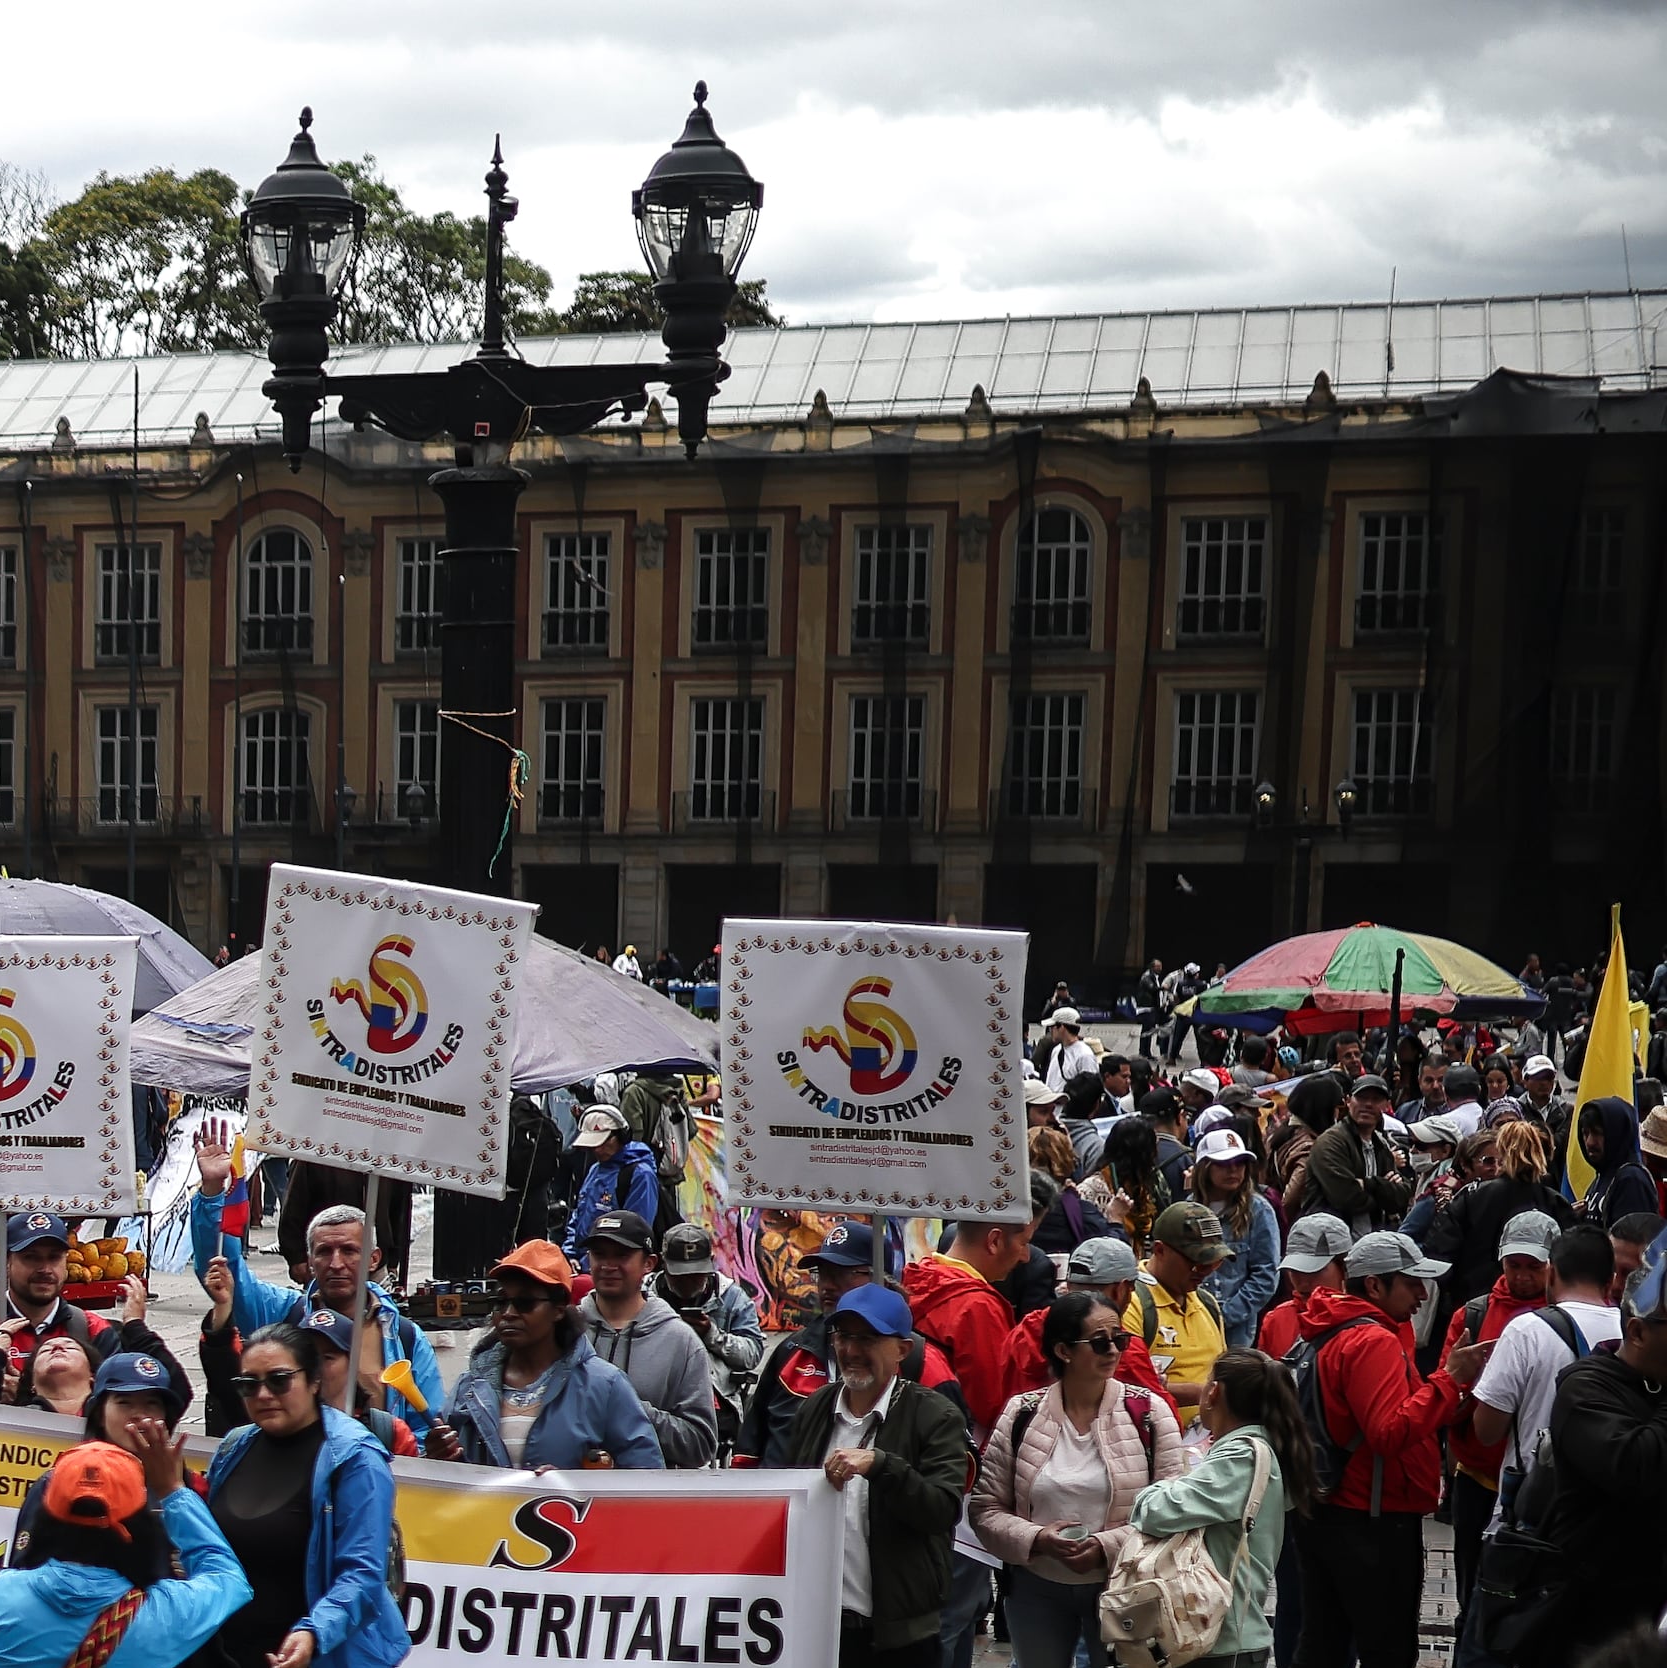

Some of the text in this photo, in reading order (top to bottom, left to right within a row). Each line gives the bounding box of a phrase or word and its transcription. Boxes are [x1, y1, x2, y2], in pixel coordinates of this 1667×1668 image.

[306, 998, 464, 1085] SINTRADISTRITALES
[292, 1072, 336, 1091] SINDICATO
[337, 1081, 348, 1094] DE
[349, 1083, 396, 1104] EMPLEADOS
[405, 1093, 466, 1117] TRABAJADORES
[777, 1050, 962, 1124] SINTRADISTRITALES
[322, 1108, 423, 1134] sintradistritalesjd@gmail.com
[769, 1125, 820, 1138] SINDICATO
[822, 1127, 835, 1140] DE
[836, 1128, 892, 1141] EMPLEADOS
[902, 1131, 974, 1147] TRABAJADORES
[21, 1136, 85, 1148] TRABAJADORES
[809, 1155, 927, 1169] sintradistritalesjd@gmail.com
[684, 1243, 697, 1260] P
[488, 1495, 593, 1571] S
[403, 1581, 784, 1666] DISTRITALES
